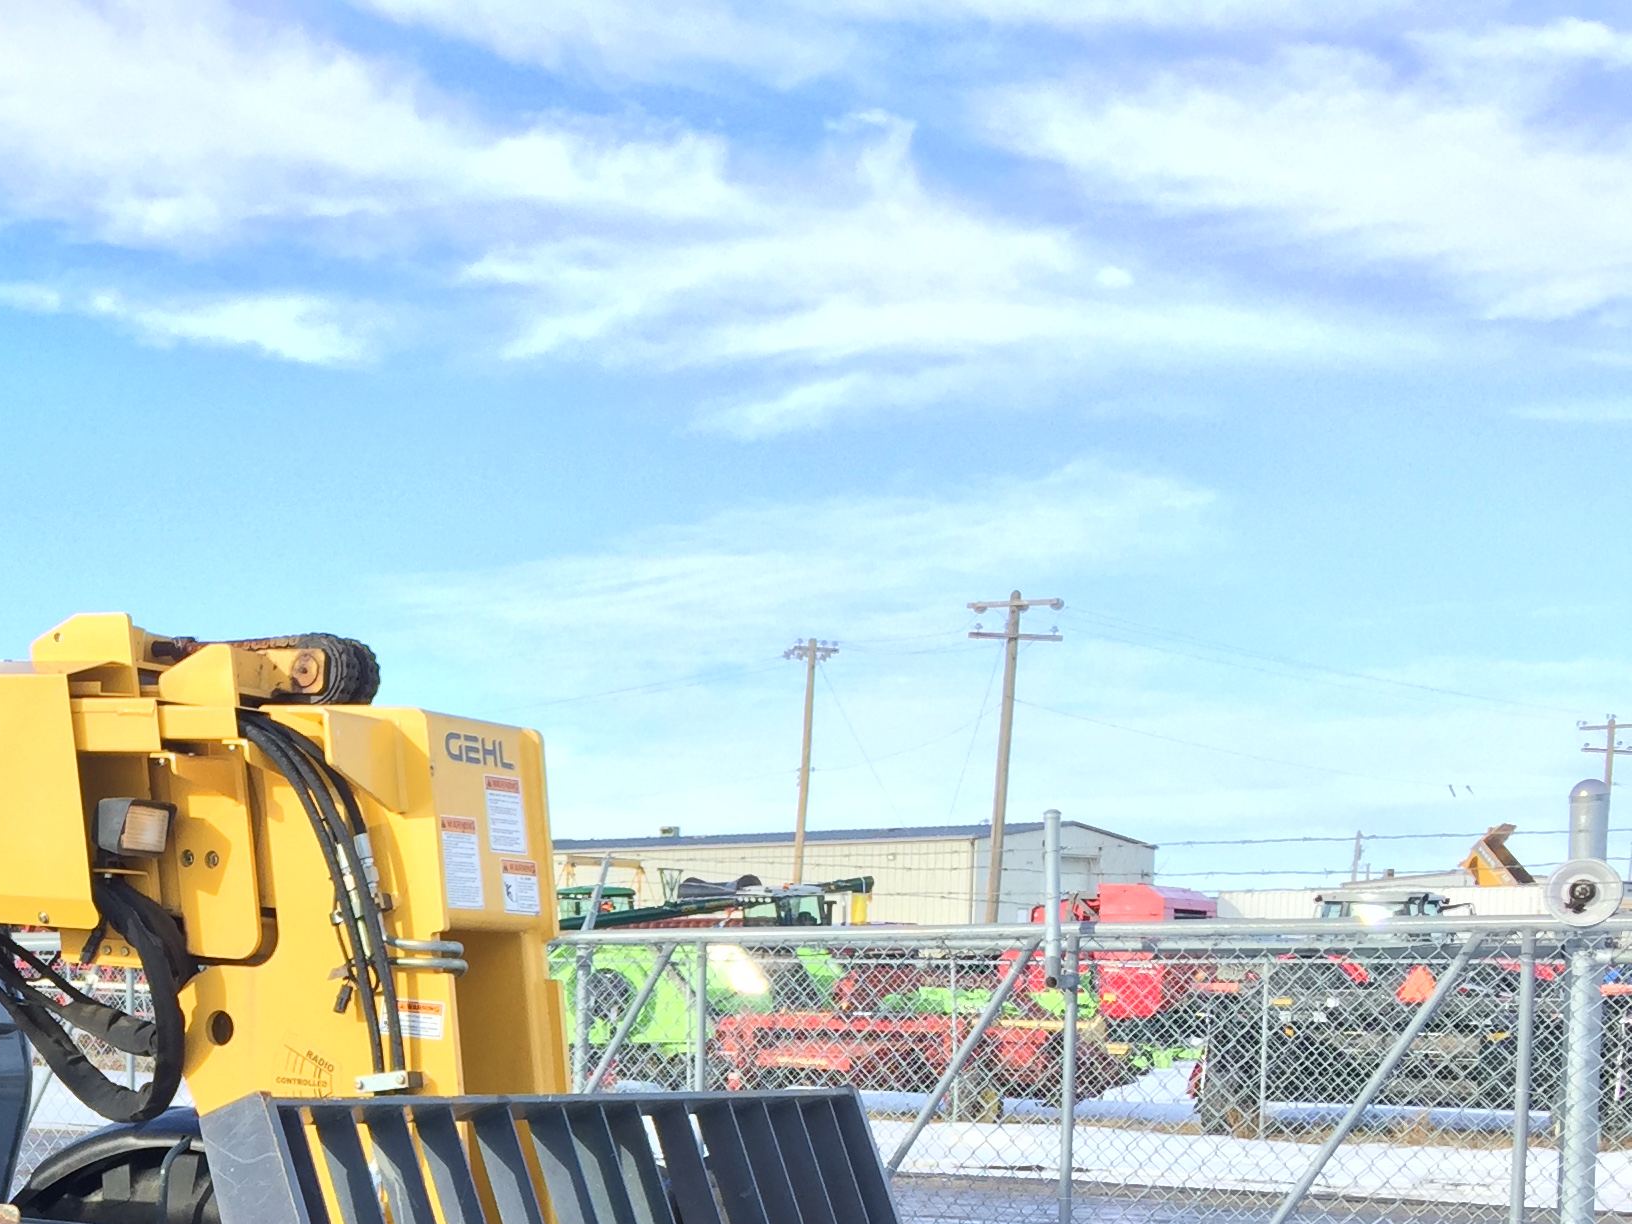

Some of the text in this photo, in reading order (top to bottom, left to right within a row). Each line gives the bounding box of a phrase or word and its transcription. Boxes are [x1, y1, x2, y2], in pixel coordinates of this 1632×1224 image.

[445, 732, 515, 770] GEHL
[447, 819, 475, 831] WARNING
[509, 863, 536, 875] WARNING
[407, 1002, 440, 1013] WARNING
[305, 1049, 336, 1073] RADIO
[275, 1075, 328, 1089] CONTROLLED
